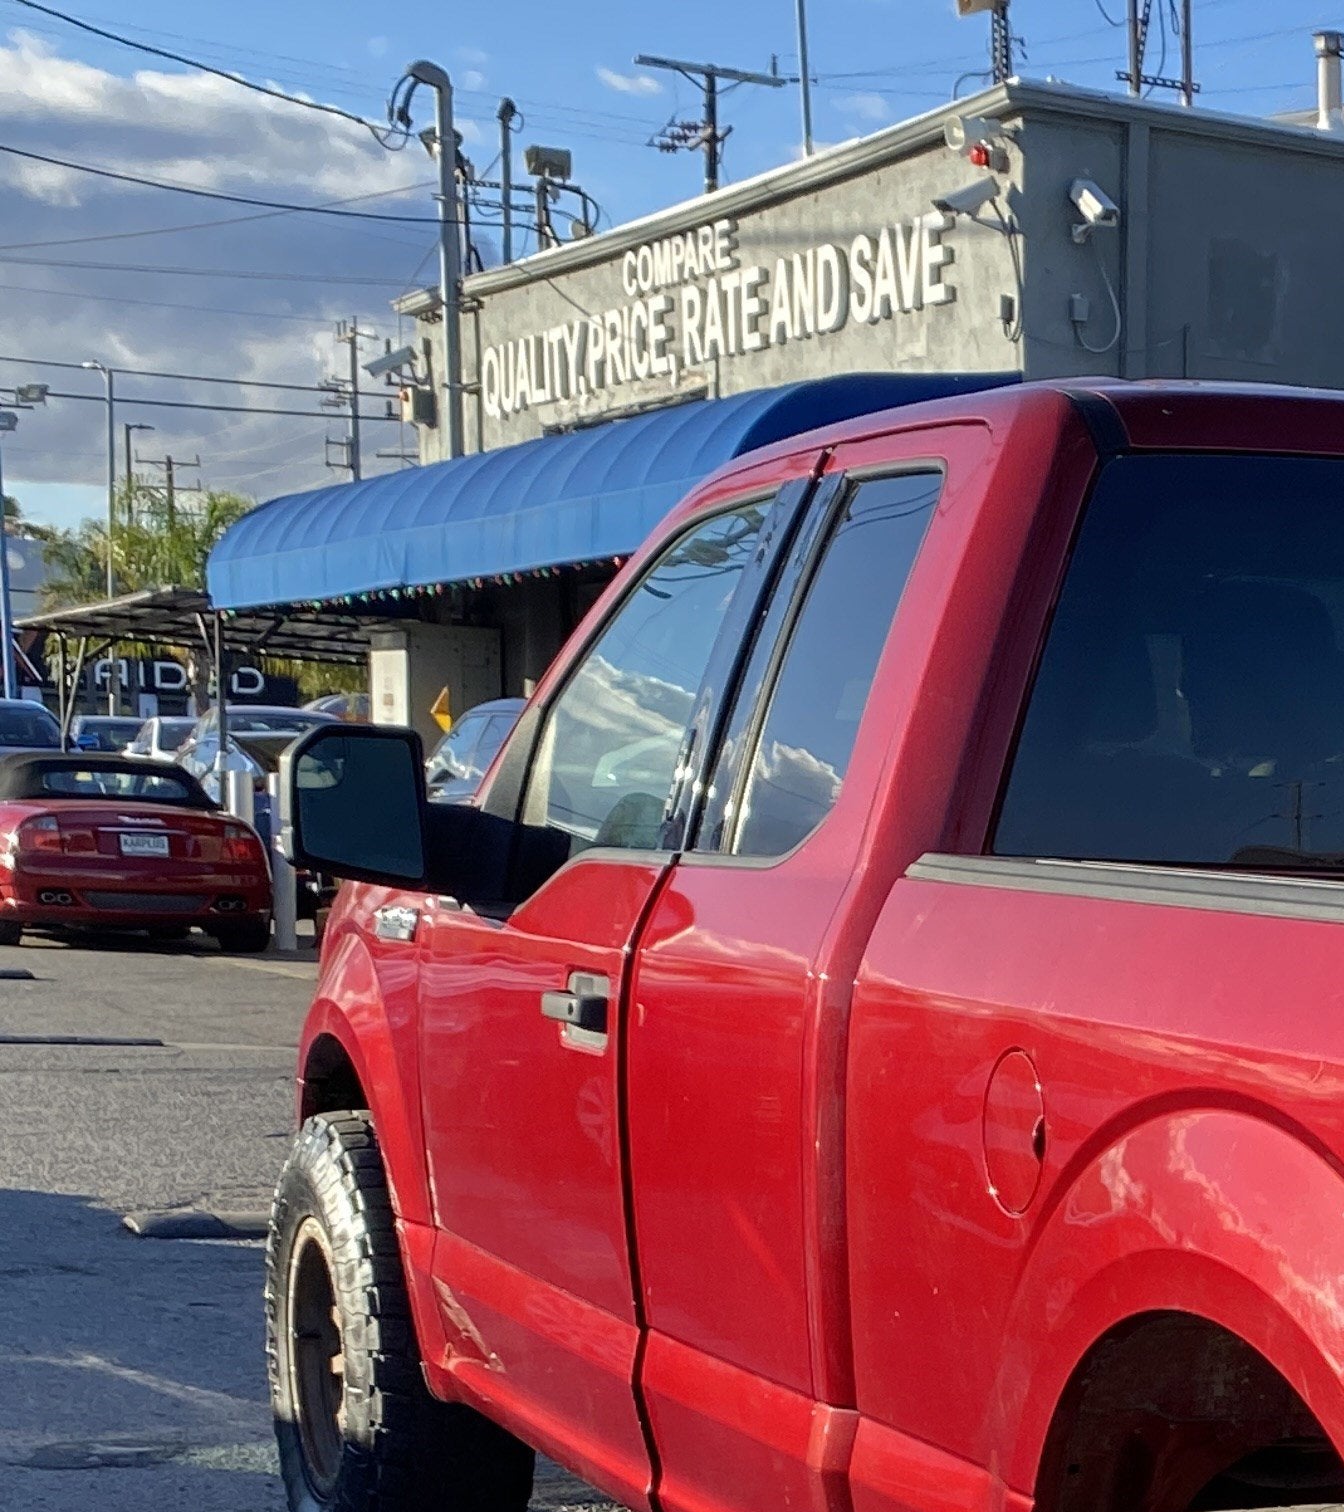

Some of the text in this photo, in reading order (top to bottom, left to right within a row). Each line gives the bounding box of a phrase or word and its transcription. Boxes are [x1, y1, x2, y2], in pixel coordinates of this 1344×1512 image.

[482, 211, 949, 420] QUALITY, PRICE, RATE AND SAVE
[623, 218, 737, 297] COMPARE
